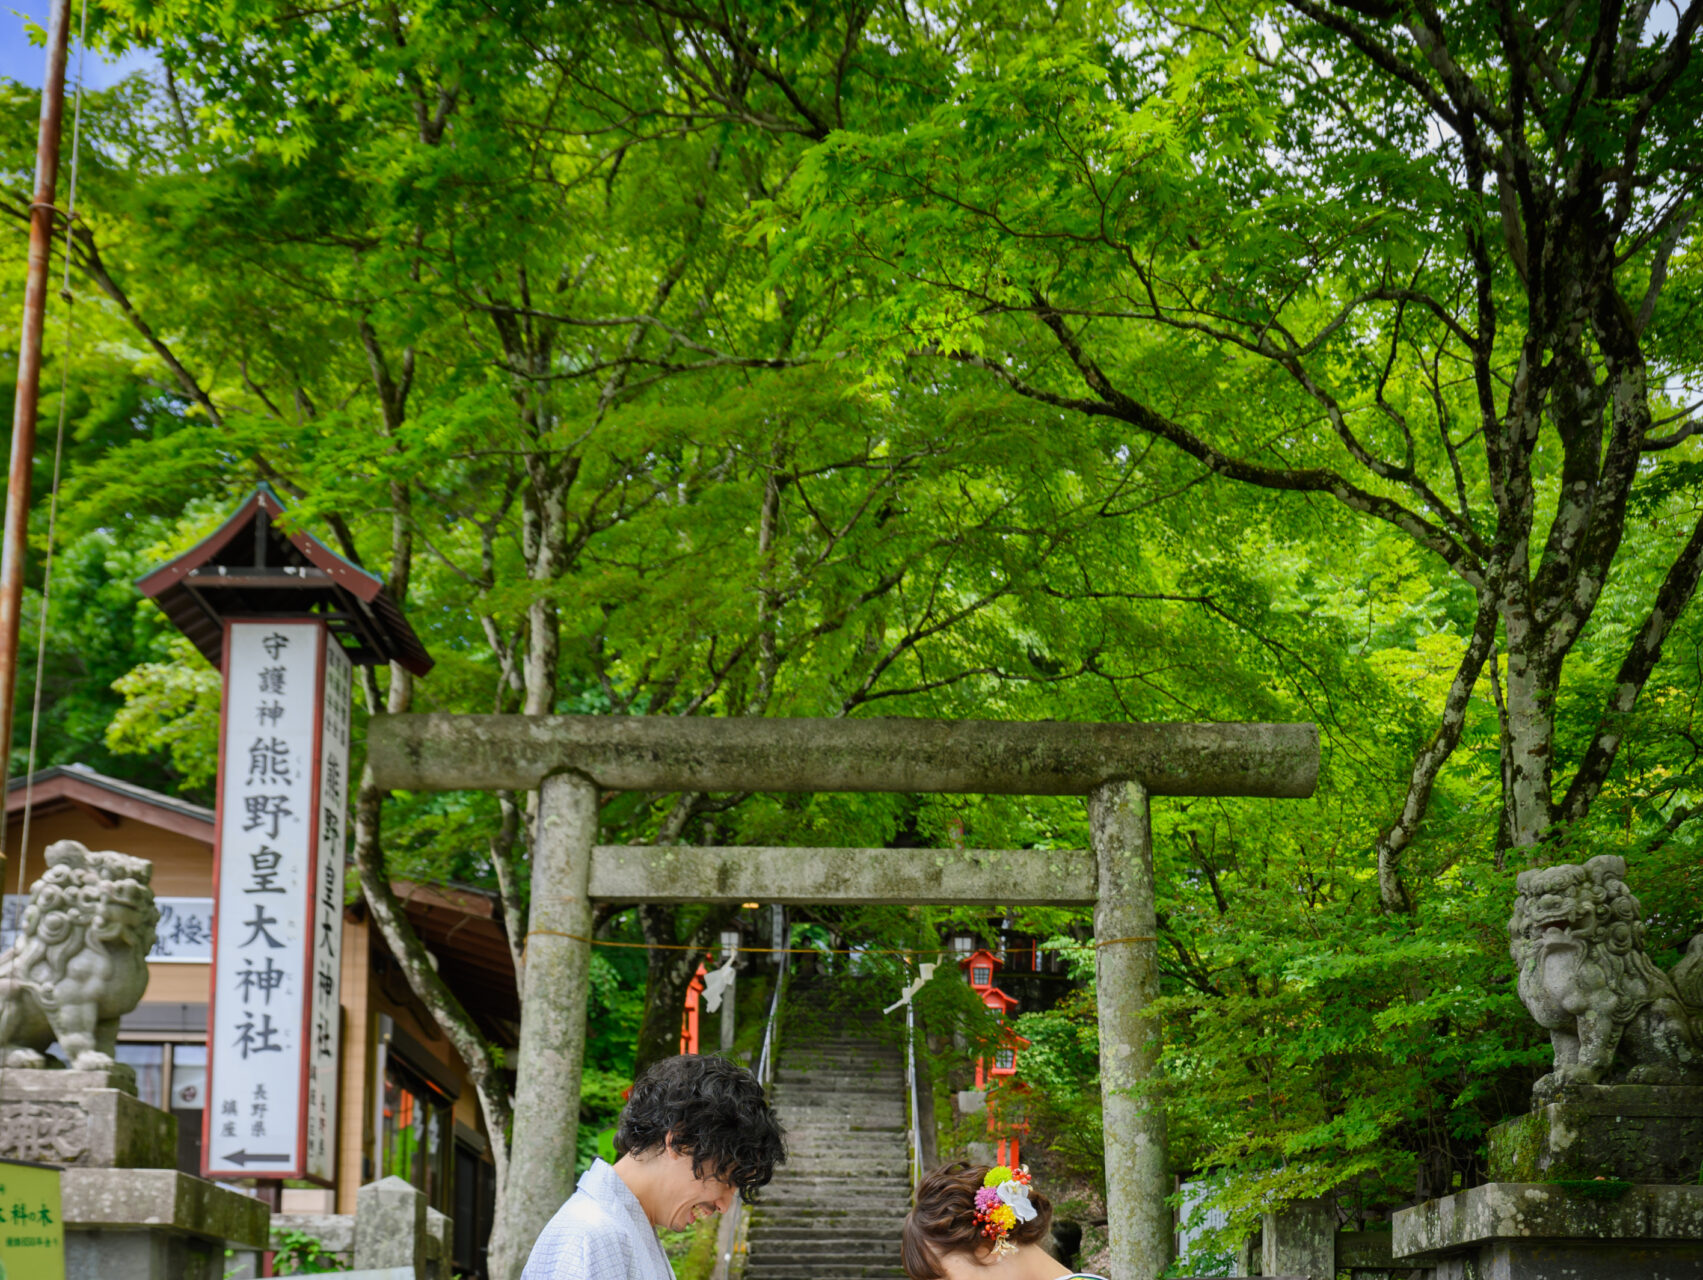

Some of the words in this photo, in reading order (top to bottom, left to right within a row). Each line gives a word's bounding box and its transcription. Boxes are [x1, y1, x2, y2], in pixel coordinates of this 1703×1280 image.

[258, 631, 290, 728] 守護神
[231, 735, 294, 1061] 熊野皇大神社
[220, 1099, 239, 1138] 鎮座
[250, 1083, 269, 1138] 長野県
